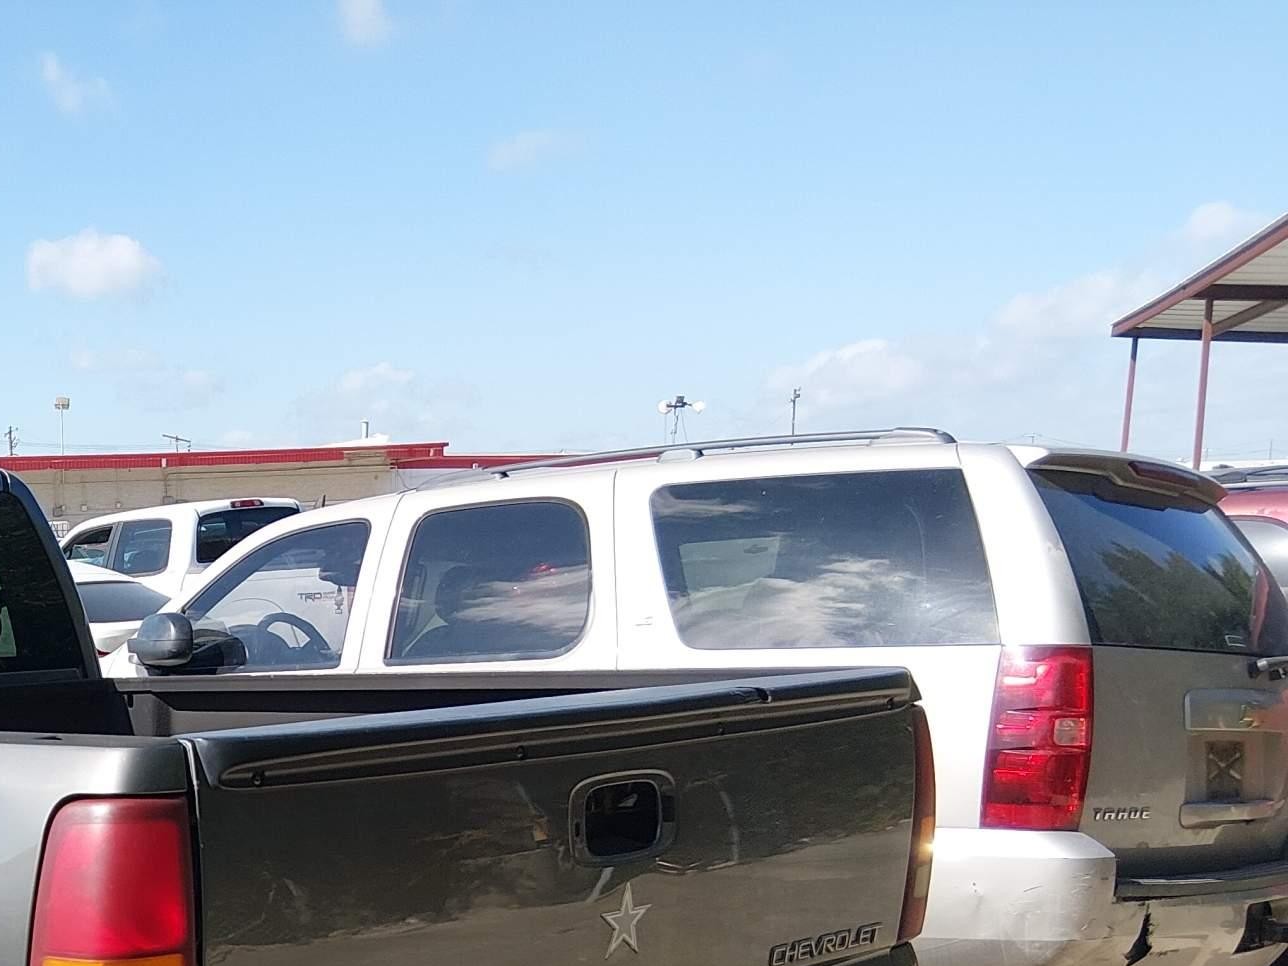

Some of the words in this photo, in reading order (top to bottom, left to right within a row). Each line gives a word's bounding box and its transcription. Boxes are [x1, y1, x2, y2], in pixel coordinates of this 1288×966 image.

[297, 592, 323, 603] TRD
[1093, 806, 1152, 821] TAHOE
[770, 923, 884, 966] CHEVROLET
